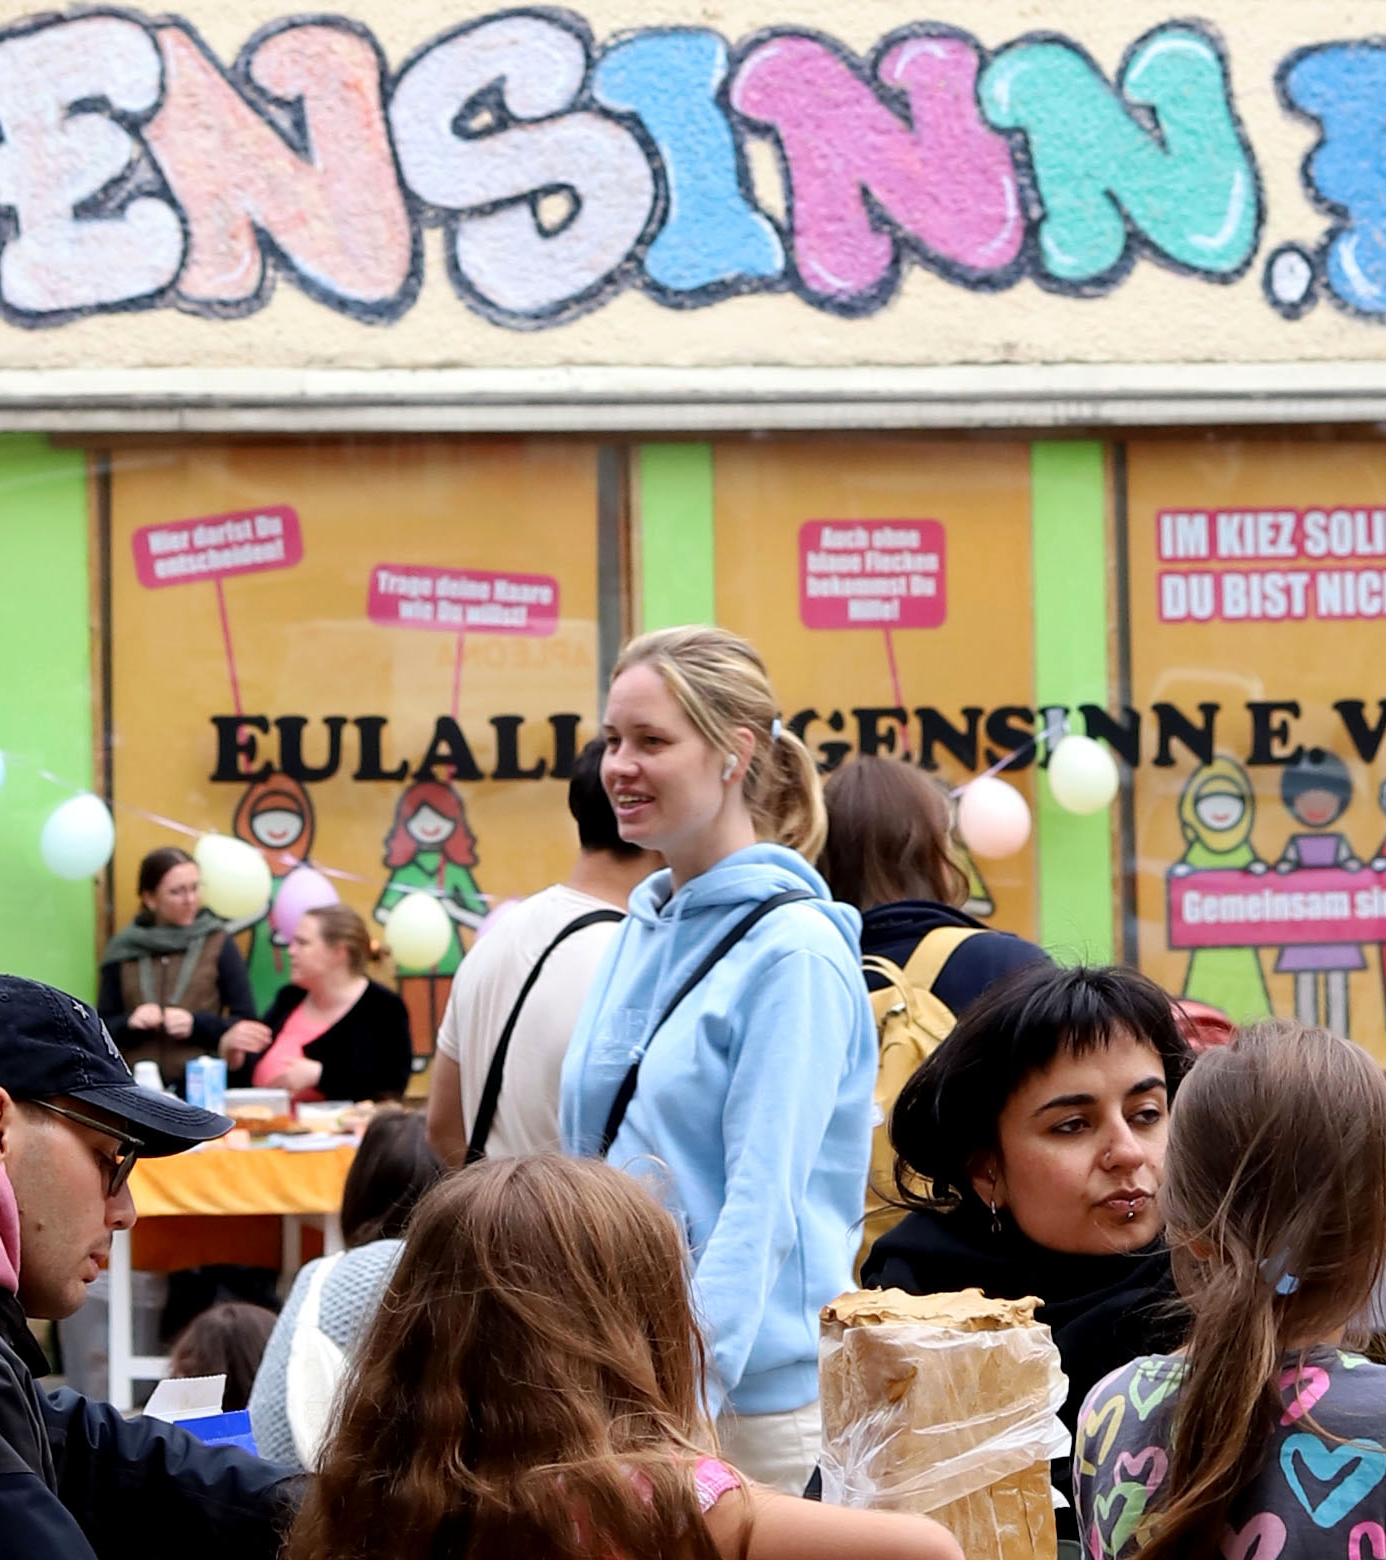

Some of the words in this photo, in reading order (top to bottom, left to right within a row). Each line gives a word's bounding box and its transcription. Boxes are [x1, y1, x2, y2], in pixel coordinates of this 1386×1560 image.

[871, 525, 921, 550] ohne
[1158, 512, 1209, 559] IM
[1216, 511, 1298, 558] KIEZ
[806, 549, 862, 575] blaue
[864, 549, 940, 574] Flecken
[1161, 572, 1215, 620] DU
[1221, 570, 1311, 619] BIST
[210, 713, 583, 783] EULALI
[1181, 887, 1351, 925] Gemeinsam
